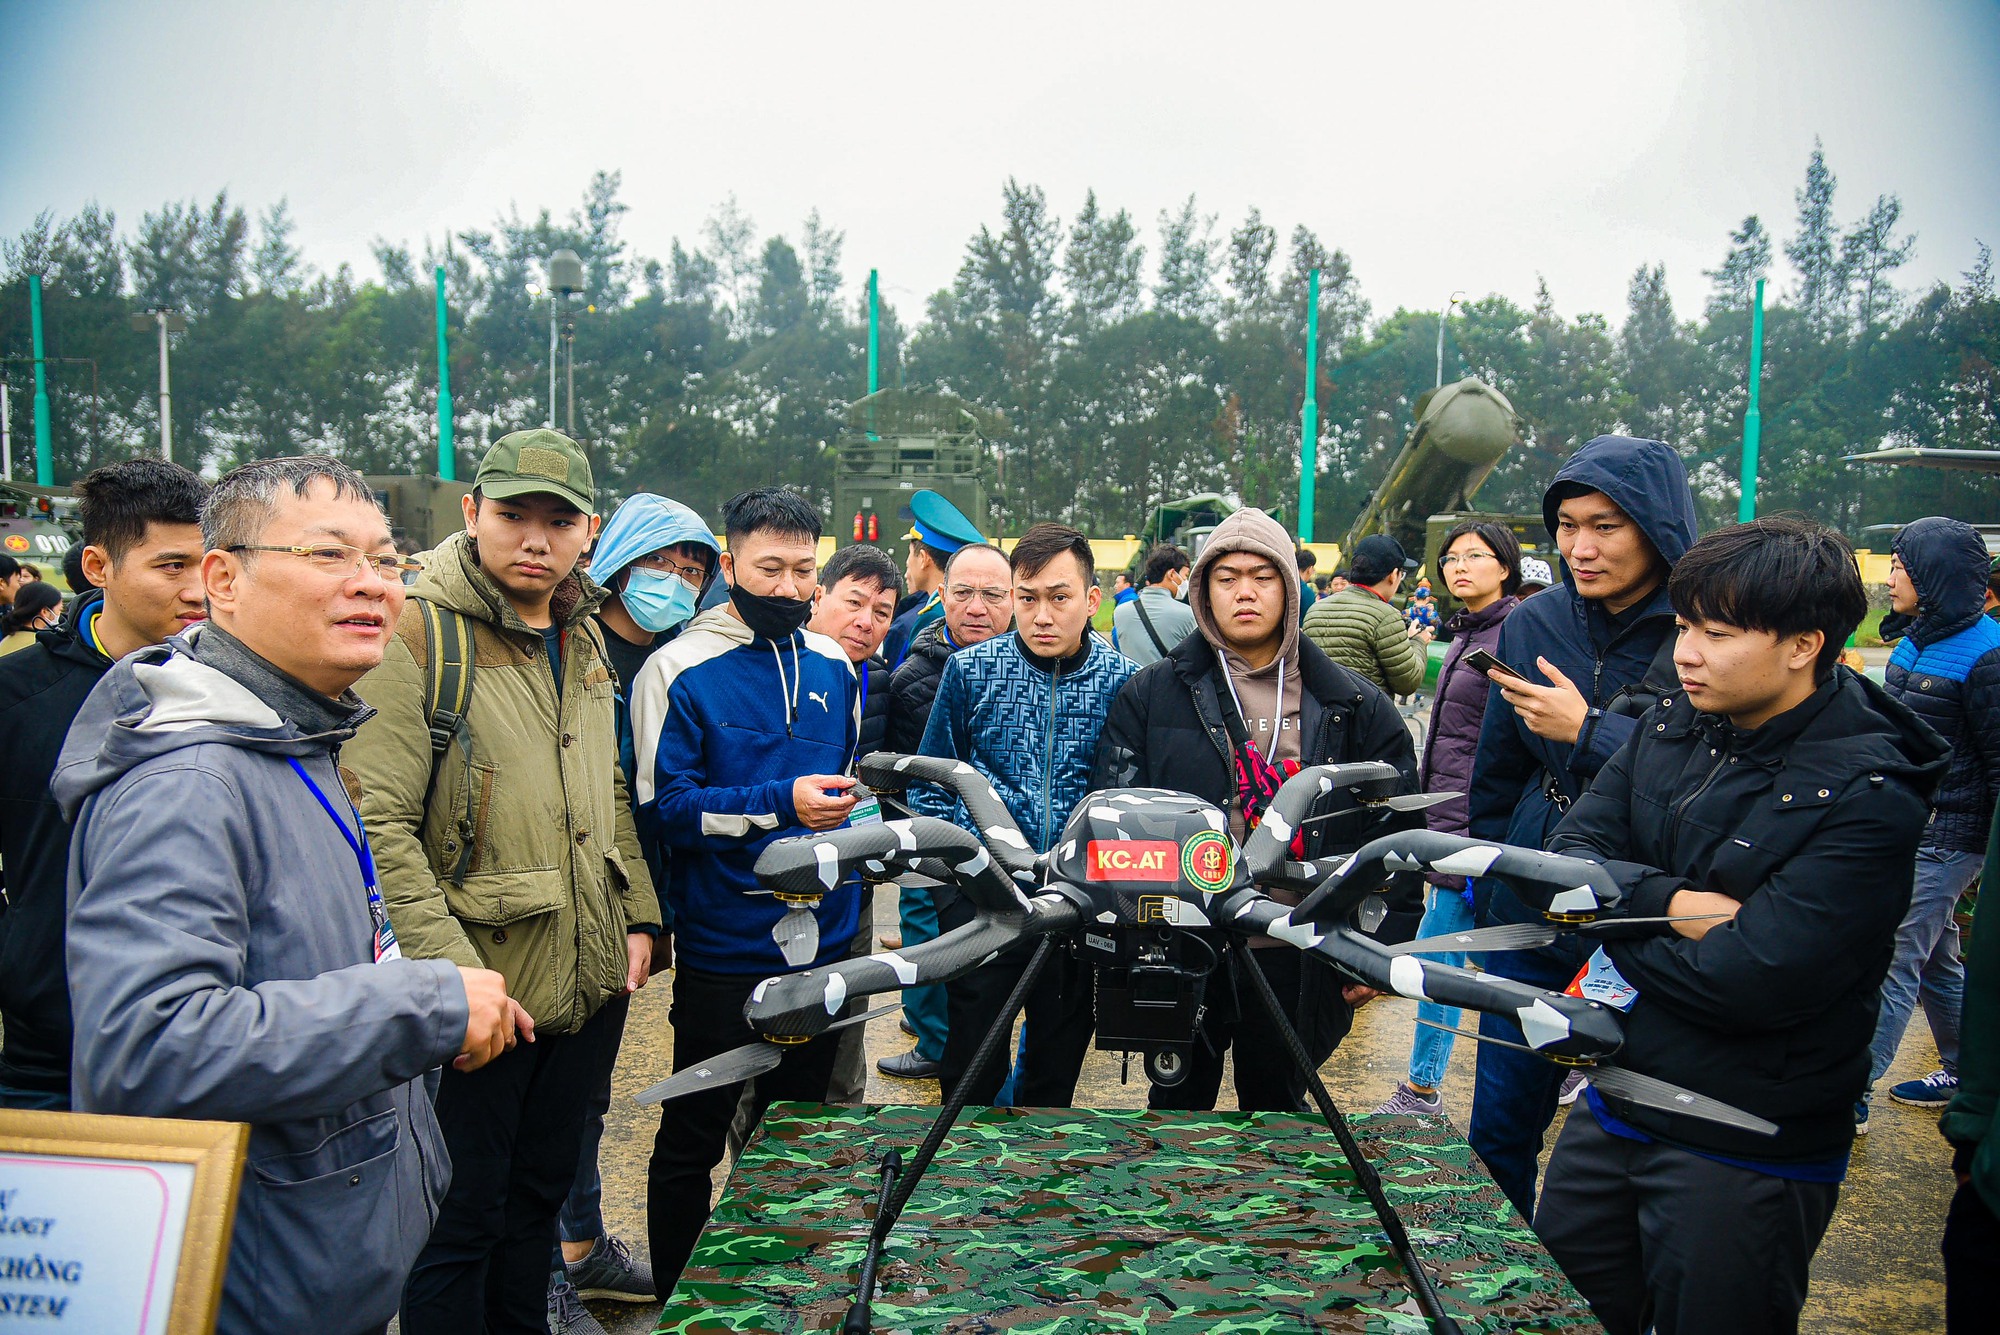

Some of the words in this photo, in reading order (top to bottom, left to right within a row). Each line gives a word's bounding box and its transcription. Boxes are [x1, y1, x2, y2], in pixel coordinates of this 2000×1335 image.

[35, 534, 71, 553] 010
[1098, 850, 1166, 869] KC.AT
[1088, 936, 1100, 946] UAV
